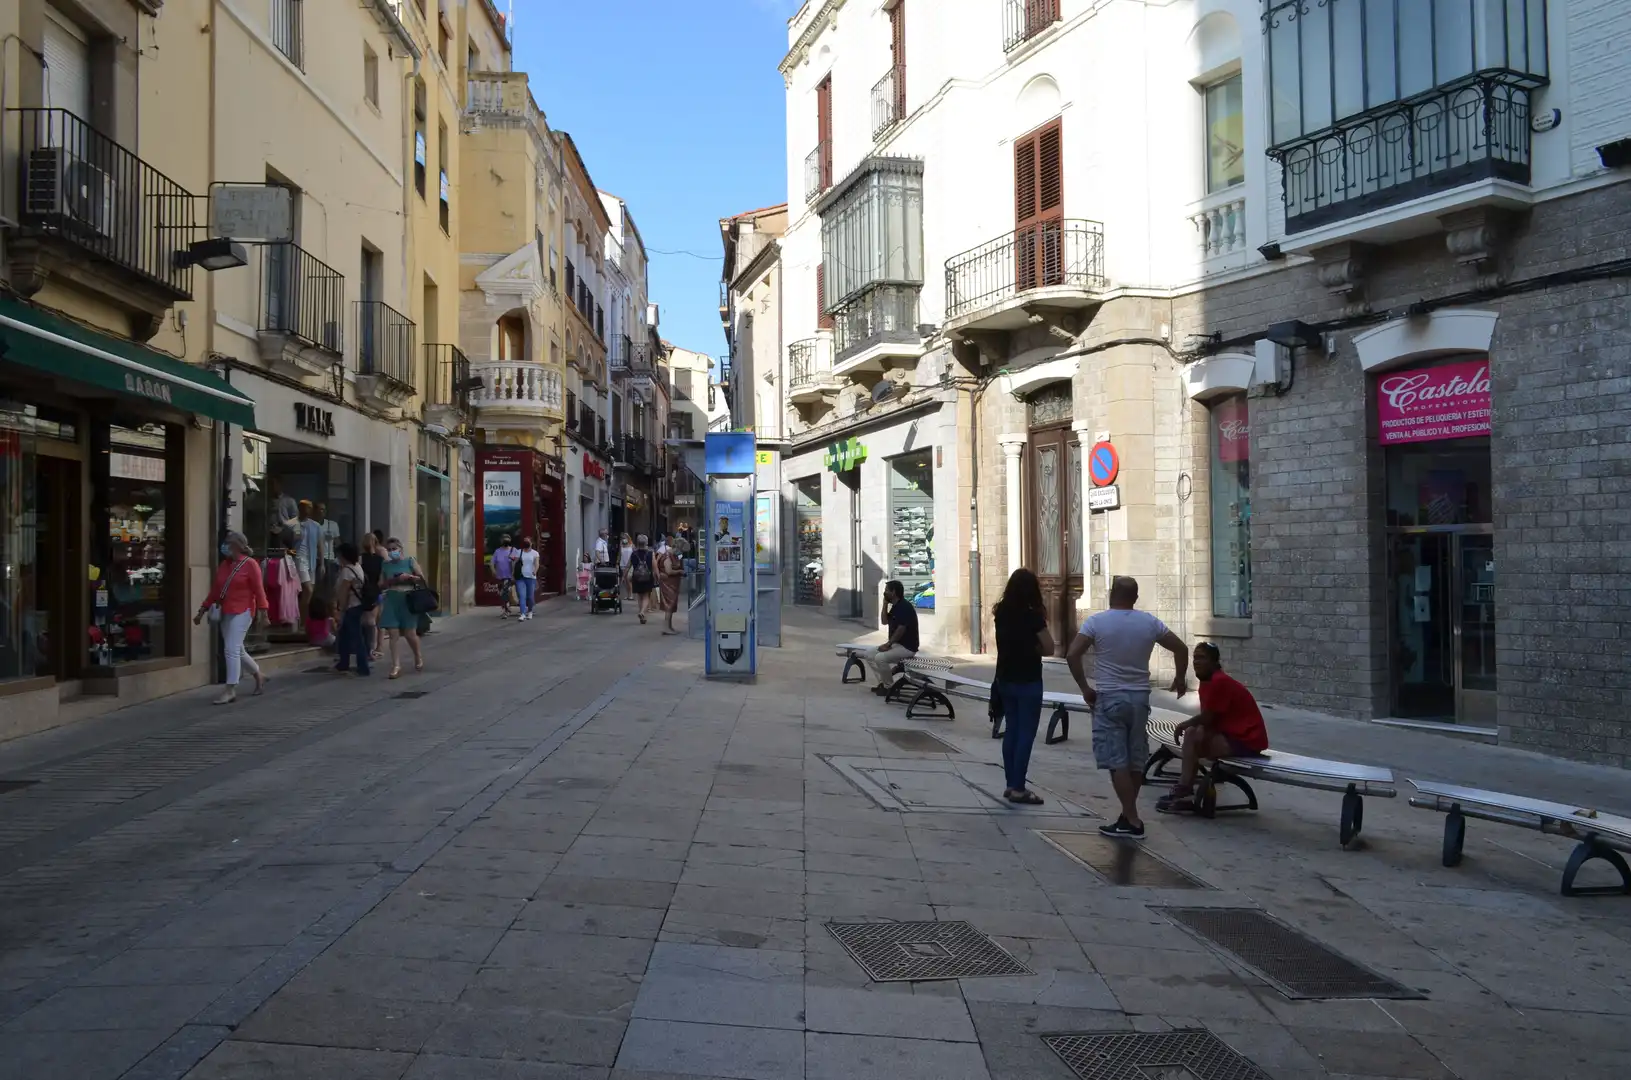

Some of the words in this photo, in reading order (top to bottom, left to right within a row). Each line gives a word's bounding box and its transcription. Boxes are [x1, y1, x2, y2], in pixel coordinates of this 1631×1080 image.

[1382, 417, 1416, 428] PRODUCTOS
[1416, 416, 1425, 424] DE
[1462, 411, 1468, 419] Y
[1386, 431, 1404, 440] VENTA
[1404, 430, 1412, 438] AL
[1437, 426, 1443, 434] Y
[1442, 425, 1451, 434] AL
[488, 488, 520, 497] Jamón
